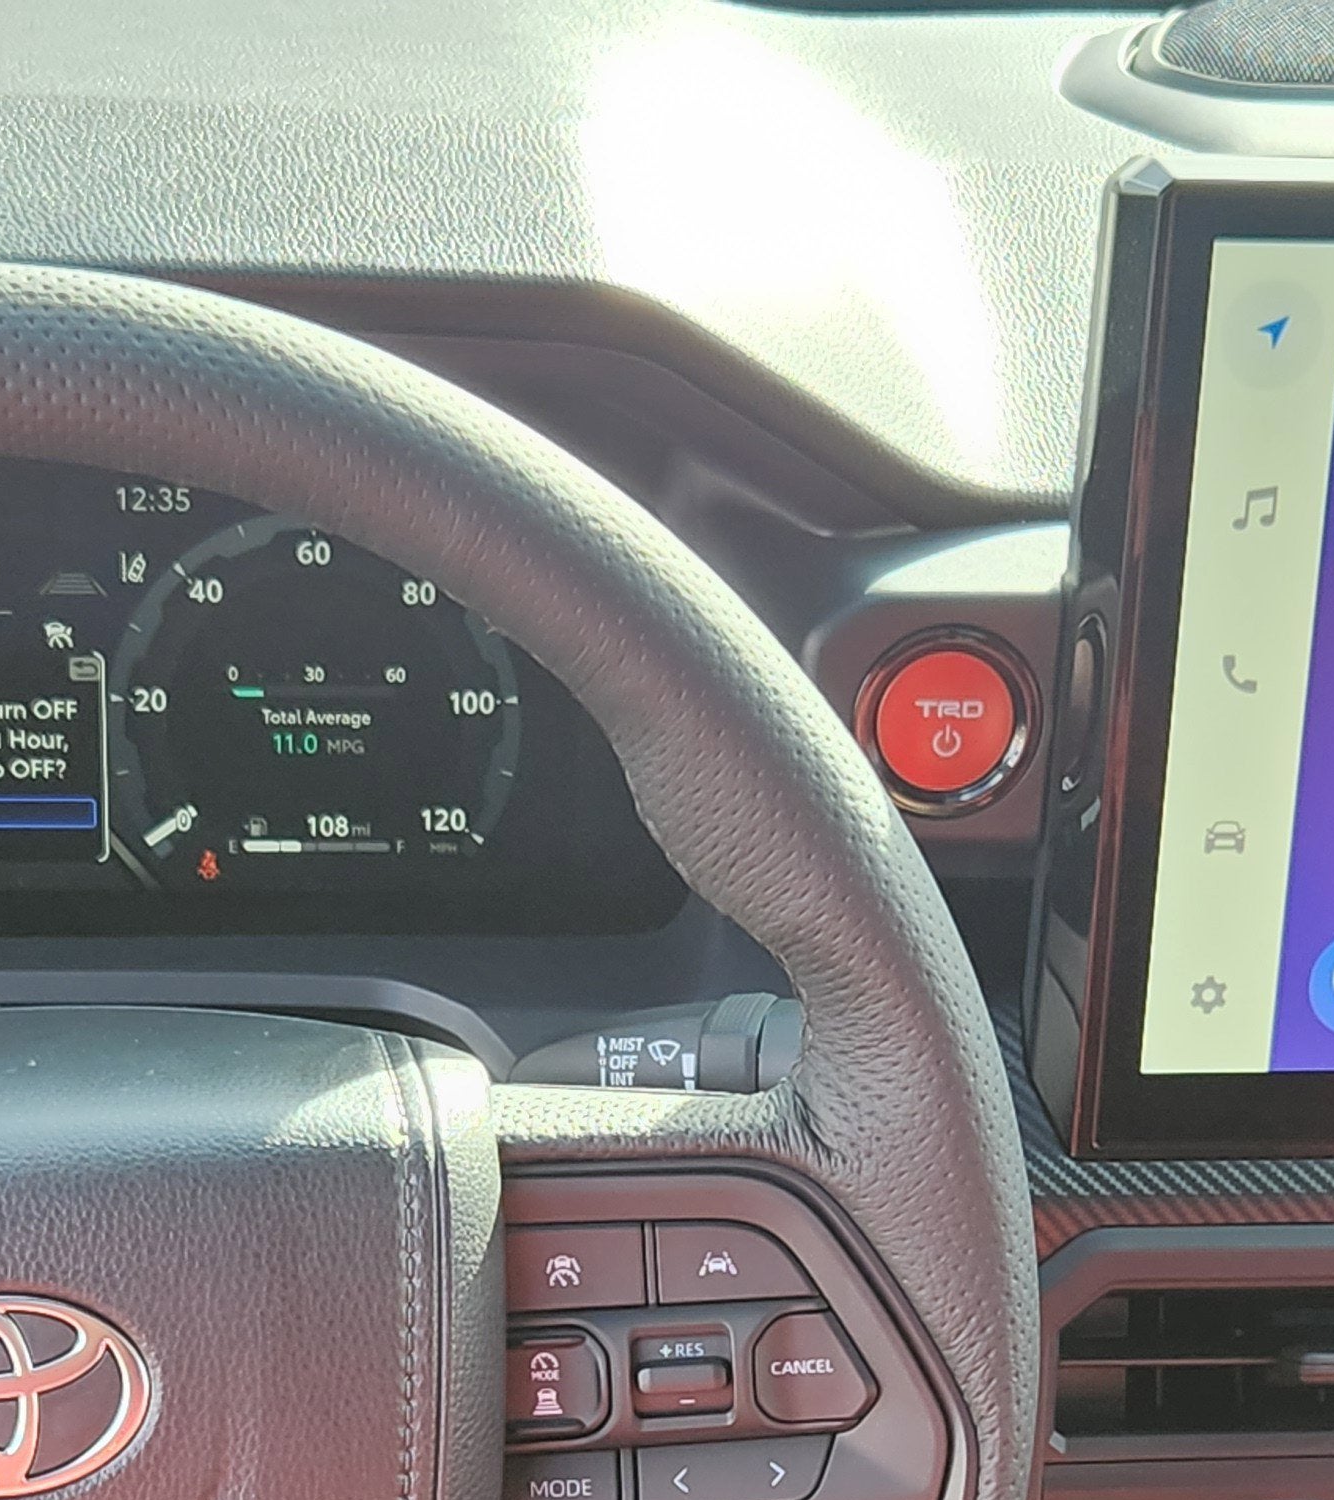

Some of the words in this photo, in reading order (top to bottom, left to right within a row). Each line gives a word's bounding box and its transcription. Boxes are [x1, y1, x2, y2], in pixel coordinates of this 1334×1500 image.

[116, 488, 191, 512] 12:35
[296, 541, 331, 565] 60
[188, 579, 223, 603] 40
[402, 582, 436, 605] 80
[226, 667, 239, 681] 0
[304, 668, 325, 682] 30
[385, 668, 406, 682] 60
[33, 700, 79, 720] OFF
[134, 689, 167, 712] 20
[450, 690, 496, 715] 100
[915, 700, 985, 719] TRD
[262, 710, 302, 726] Total
[305, 711, 371, 729] Average
[10, 731, 69, 752] Hour,
[272, 733, 318, 754] 11.0
[326, 740, 365, 754] MPG
[10, 760, 67, 779] OFF?
[421, 808, 467, 833] 120
[228, 841, 238, 854] E
[609, 1037, 644, 1052] MIST
[609, 1055, 639, 1070] OFF
[610, 1072, 635, 1086] INT
[531, 1369, 560, 1382] MODE
[770, 1359, 834, 1376] CANCEL
[530, 1478, 593, 1499] MODE
